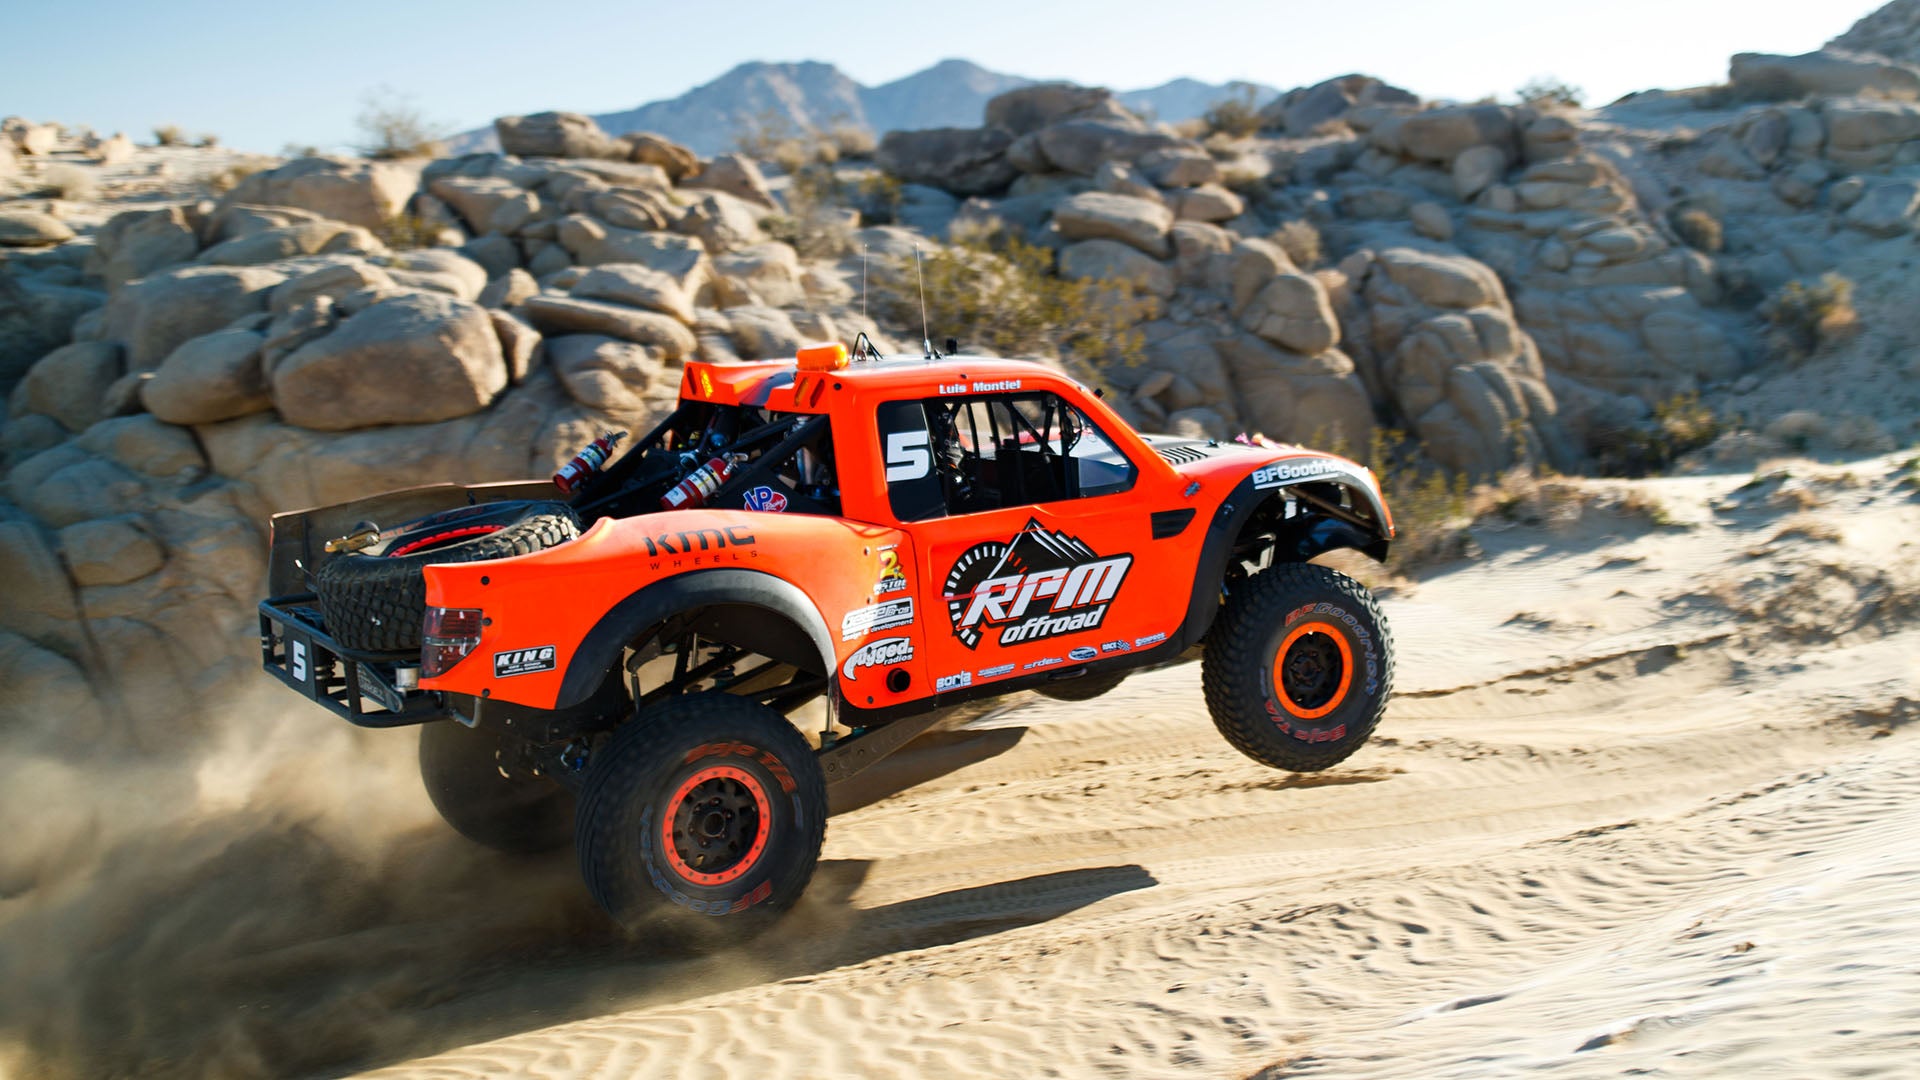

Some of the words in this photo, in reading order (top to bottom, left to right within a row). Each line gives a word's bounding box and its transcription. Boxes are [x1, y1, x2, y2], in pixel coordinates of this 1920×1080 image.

[939, 384, 967, 394] Luis
[973, 379, 1022, 392] Montiel
[886, 430, 930, 483] 5
[743, 485, 773, 512] VP
[649, 550, 758, 571] WHEELS
[960, 556, 1132, 627] RPM
[1000, 603, 1107, 645] offroad
[292, 640, 307, 682] 5
[497, 648, 554, 666] KING
[884, 653, 913, 665] radios
[1294, 723, 1347, 744] Baja
